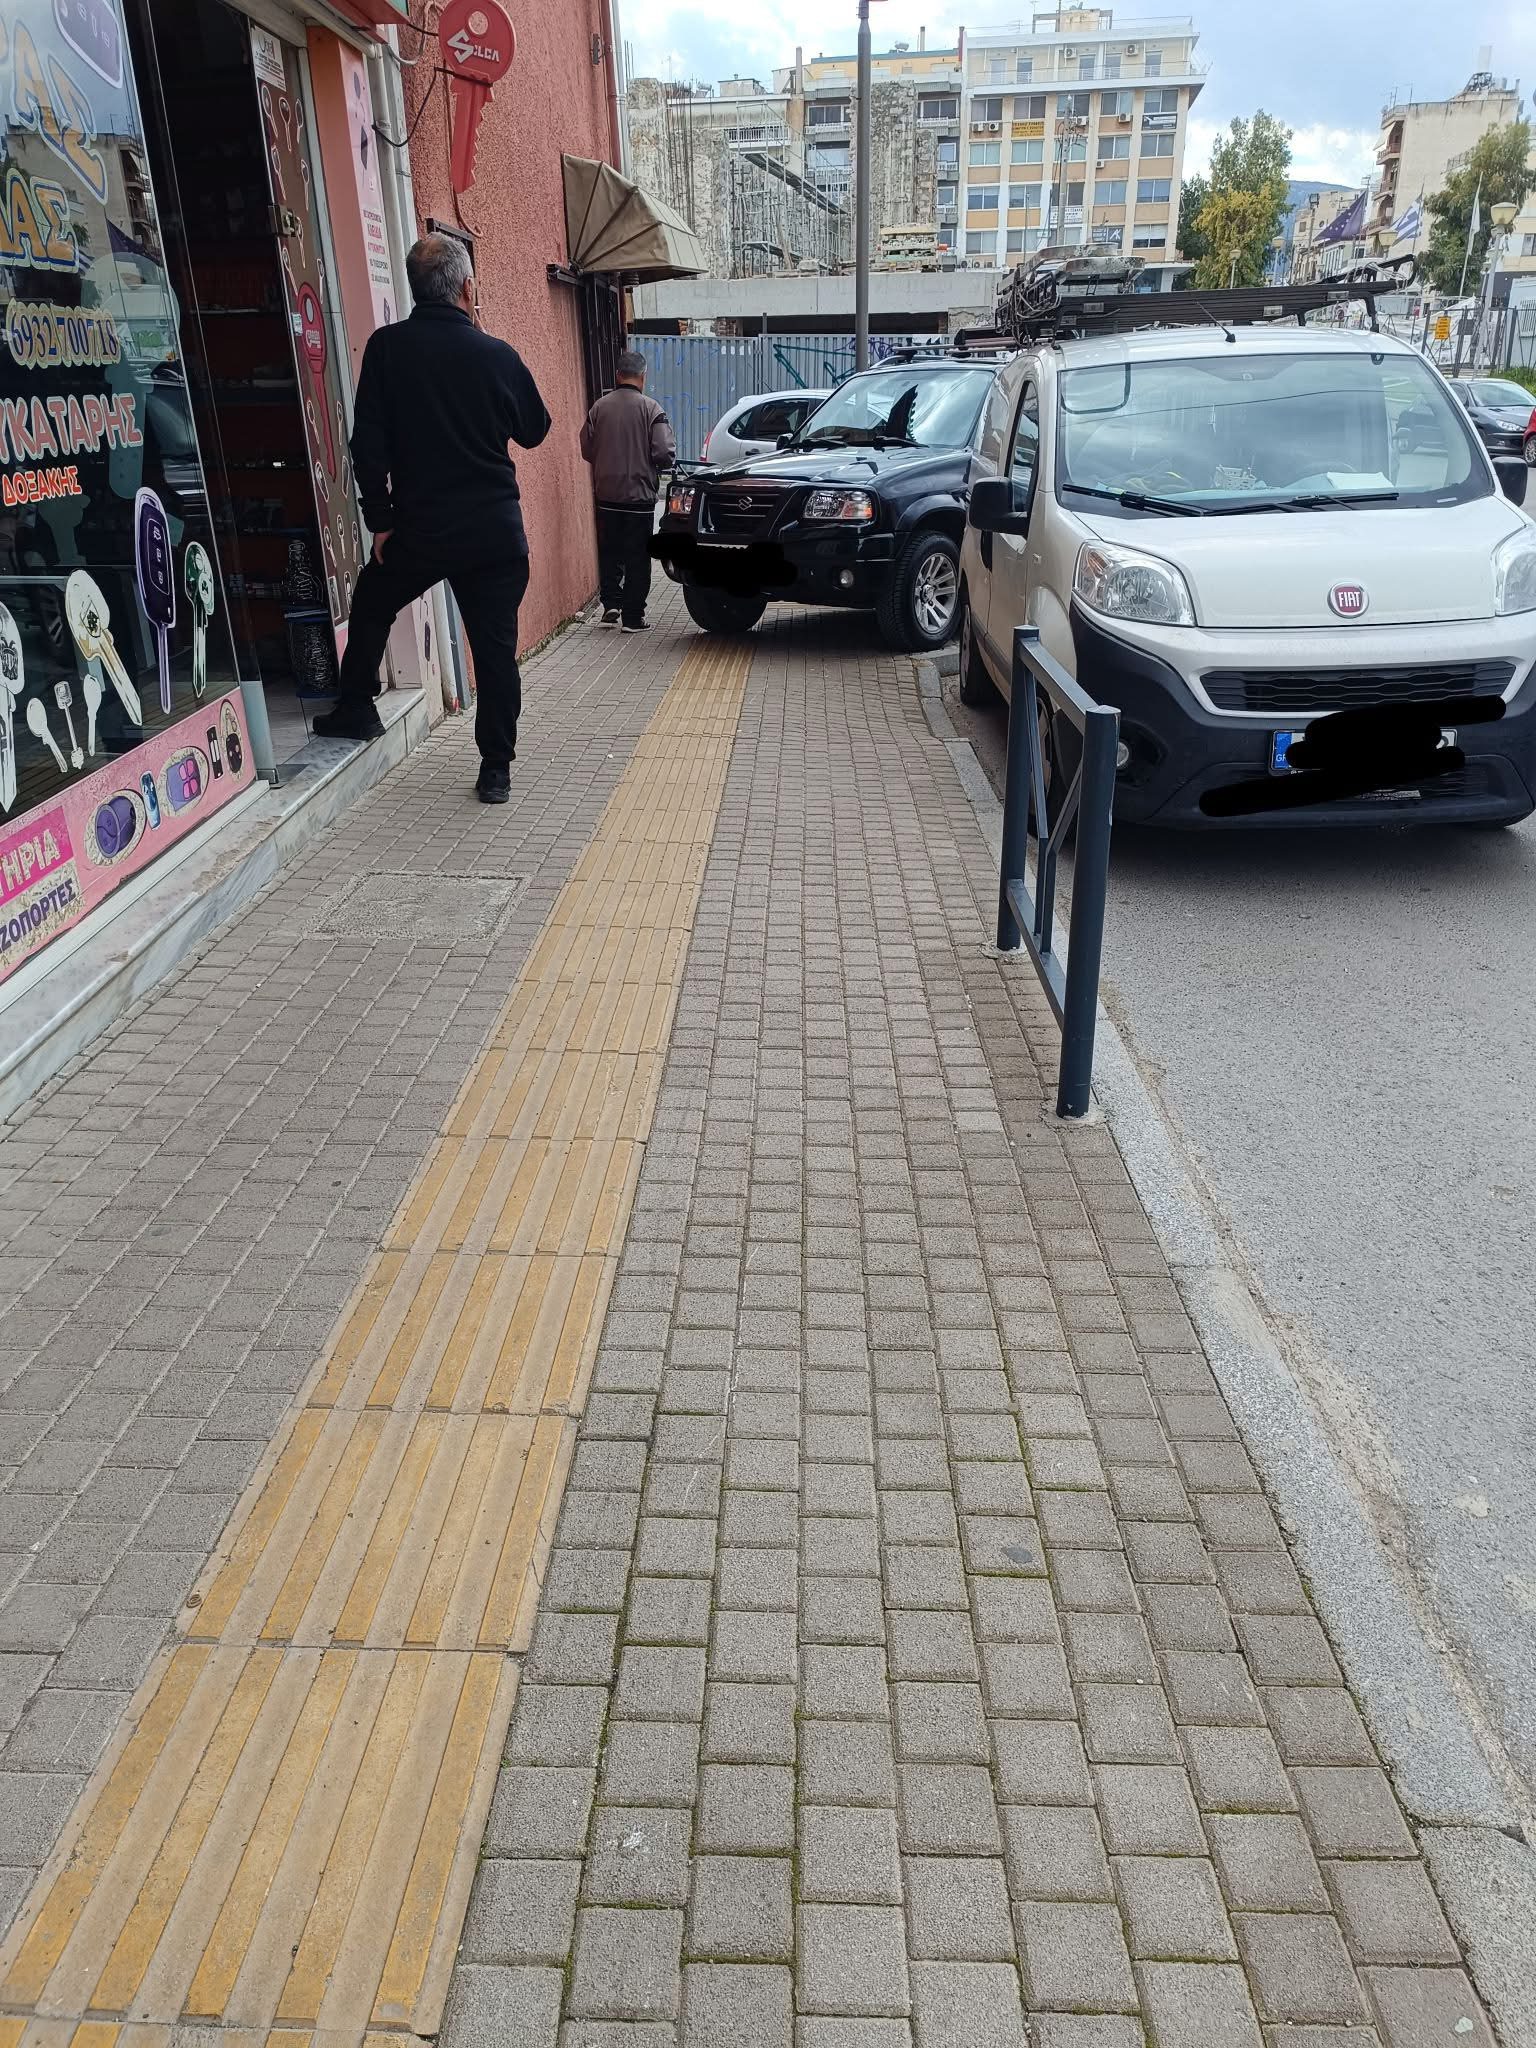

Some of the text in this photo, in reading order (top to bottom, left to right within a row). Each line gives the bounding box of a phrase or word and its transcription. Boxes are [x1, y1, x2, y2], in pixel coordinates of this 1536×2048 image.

[447, 29, 500, 63] SILCA
[2, 465, 82, 507] ΔΟΞΑΚΗΣ
[1338, 591, 1361, 608] FIAT
[0, 828, 61, 897] ΗΡΙΑ
